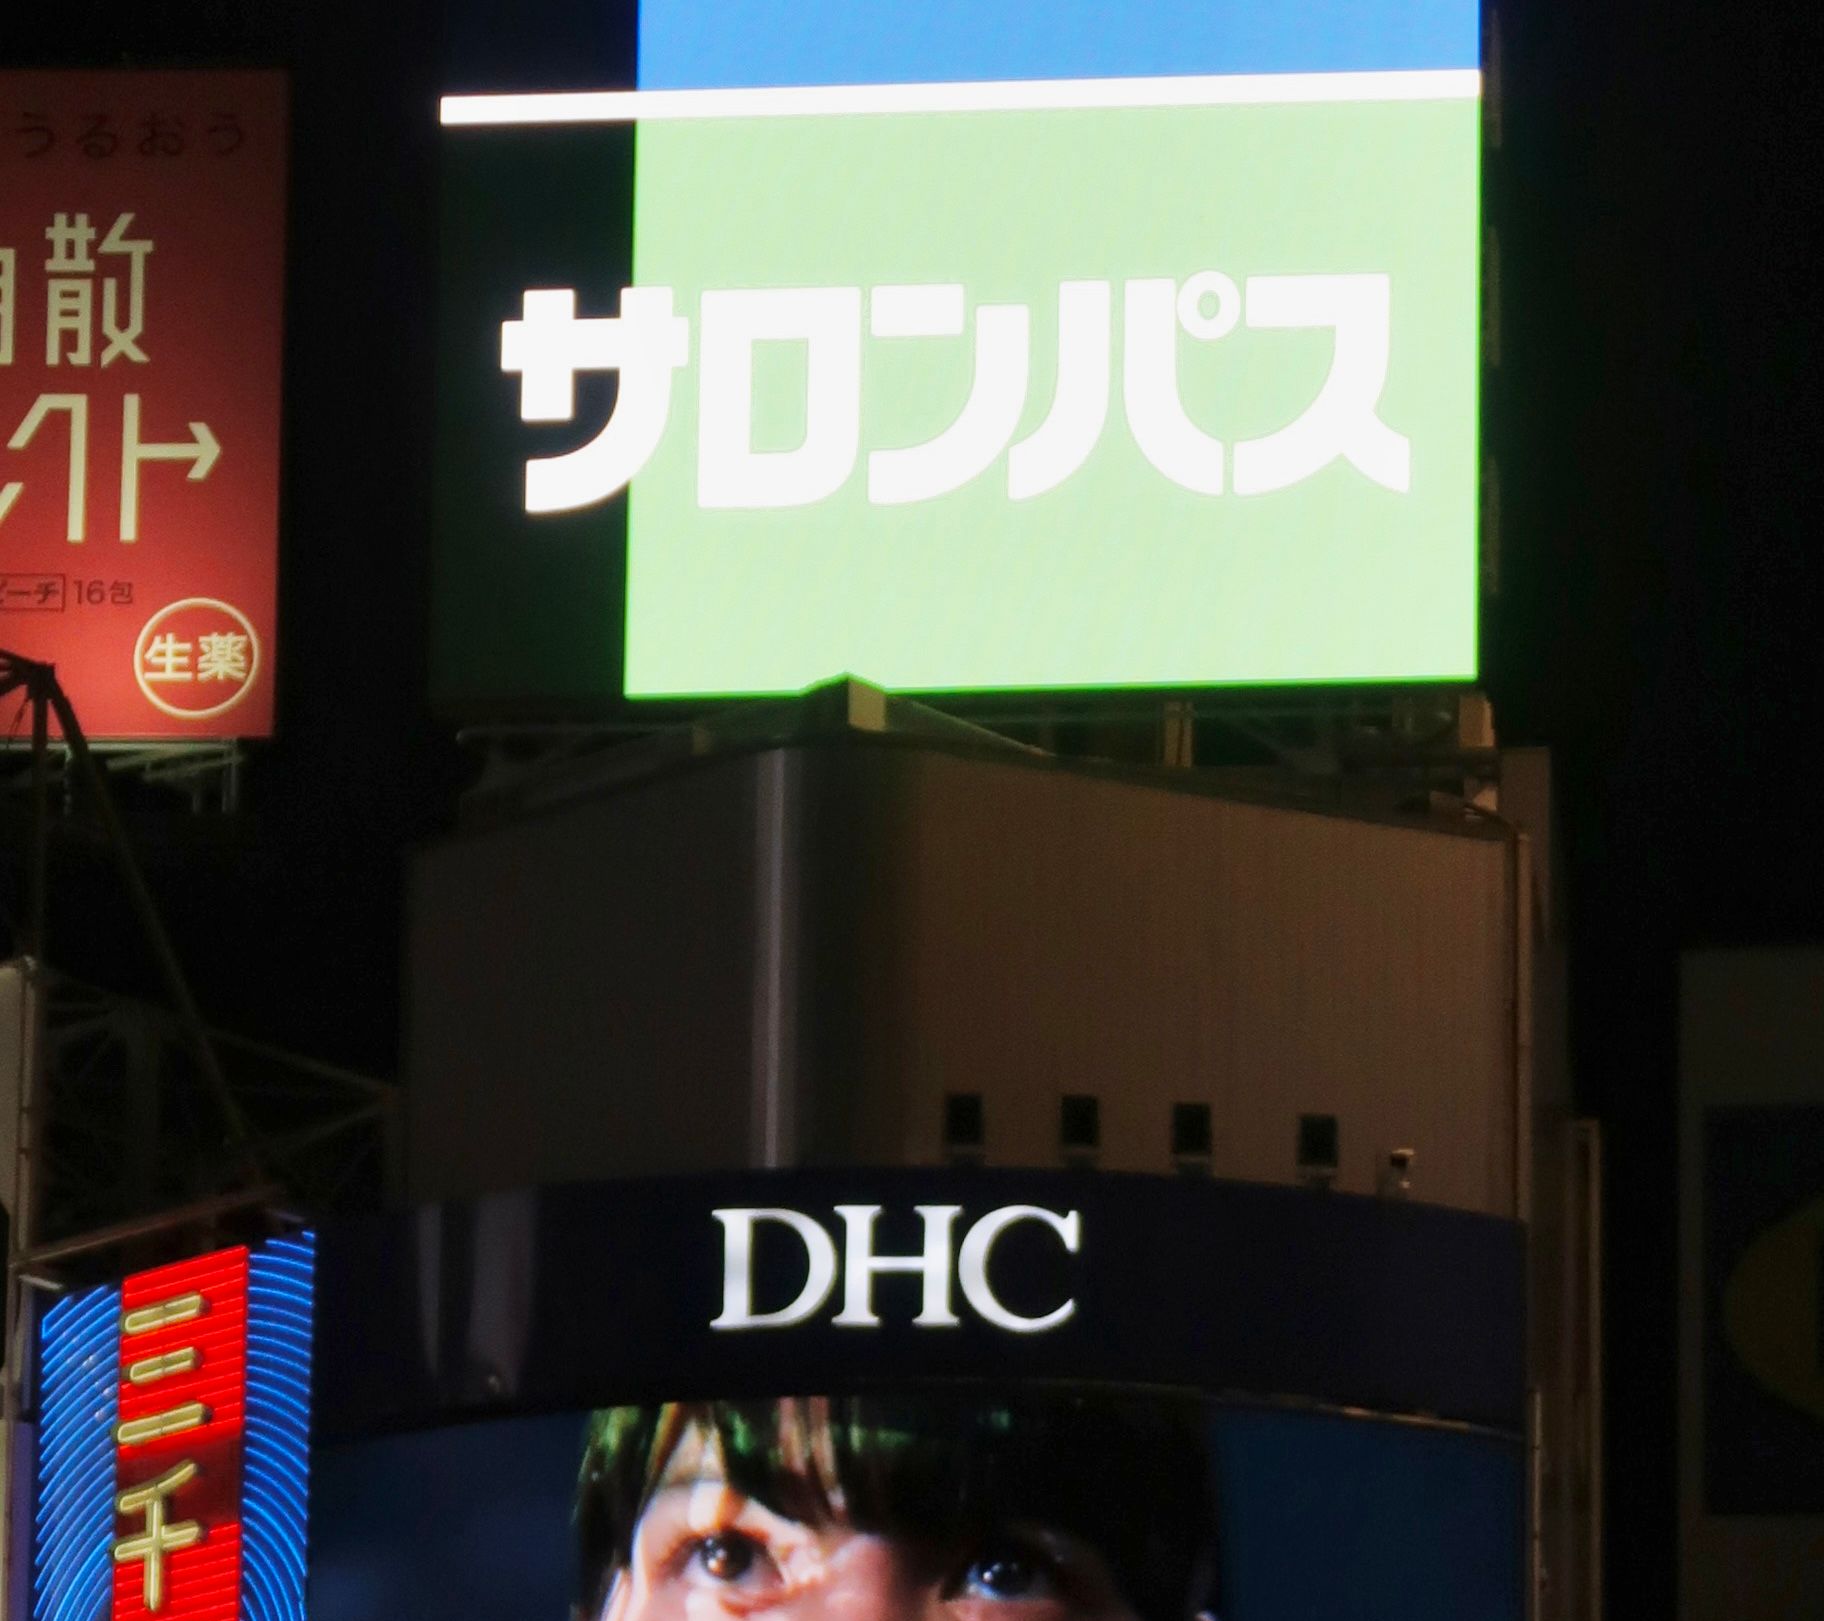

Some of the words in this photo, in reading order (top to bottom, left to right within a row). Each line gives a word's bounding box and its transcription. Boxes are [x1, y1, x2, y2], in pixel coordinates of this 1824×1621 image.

[500, 270, 1410, 513] サロンパス
[74, 578, 134, 604] 16包
[143, 630, 250, 681] 生薬
[709, 1204, 1084, 1334] DHC
